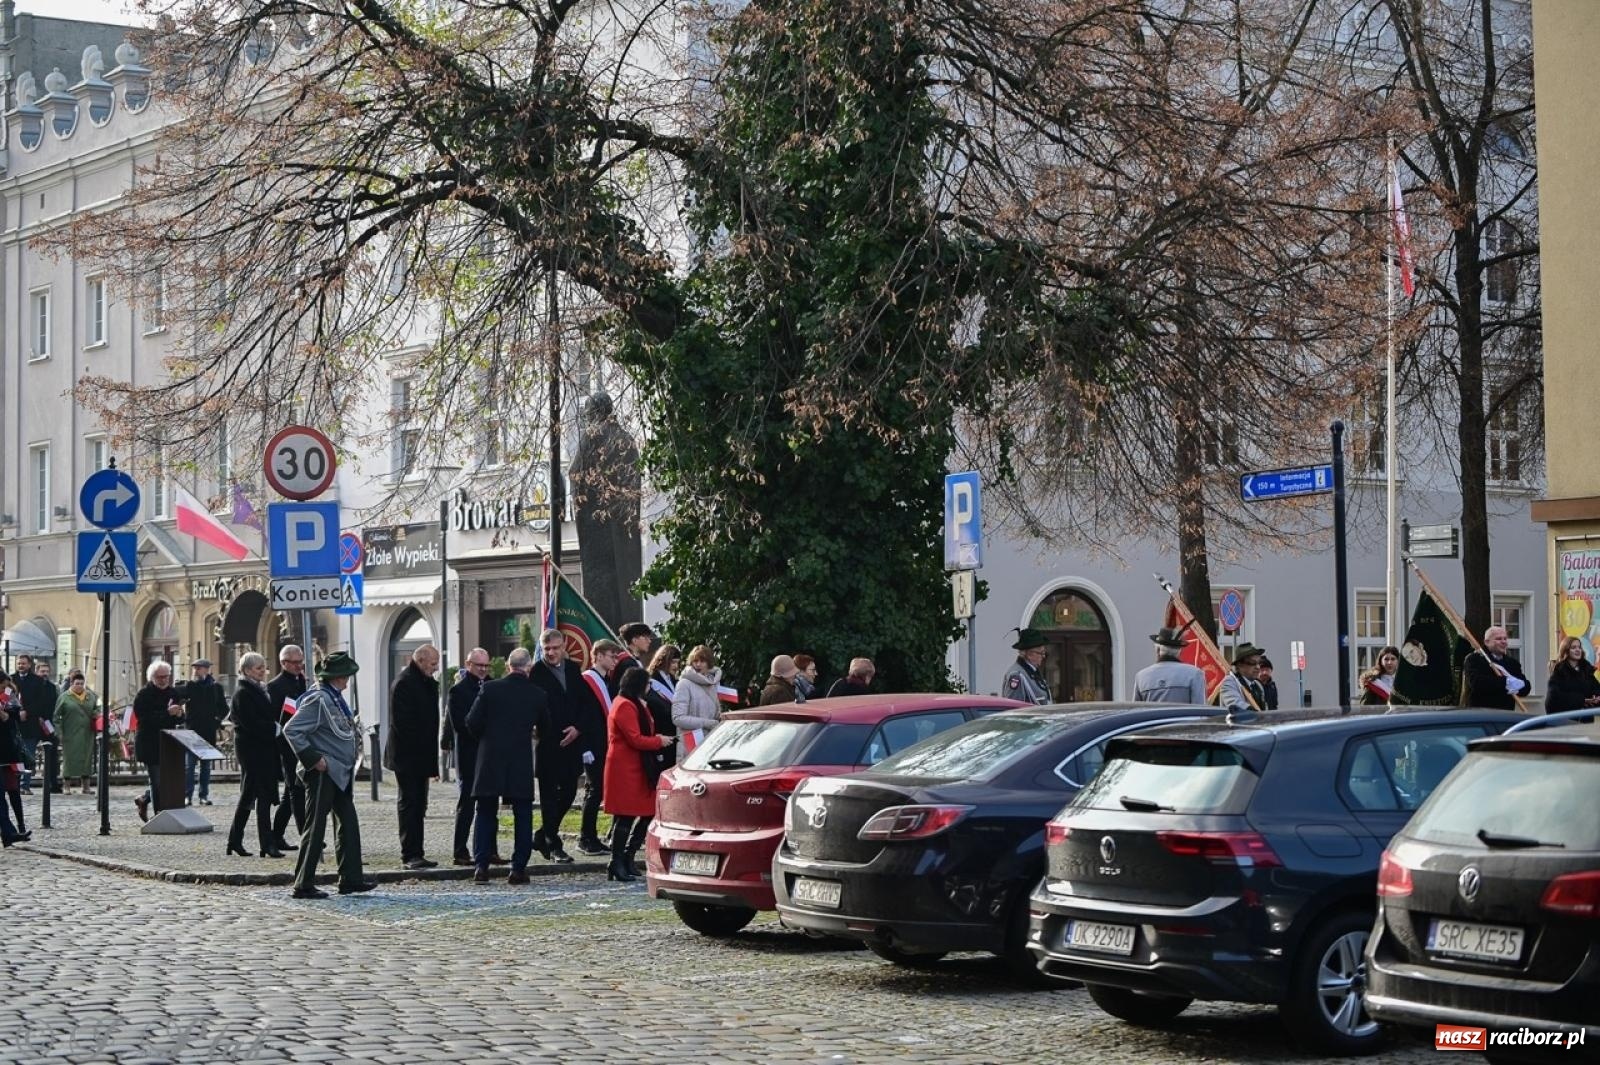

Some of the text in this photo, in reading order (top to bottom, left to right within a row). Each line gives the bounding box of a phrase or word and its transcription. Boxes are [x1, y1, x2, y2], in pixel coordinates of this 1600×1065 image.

[277, 447, 326, 481] 30
[1279, 472, 1311, 481] Informacja
[1257, 481, 1269, 491] 150
[451, 487, 519, 531] Browar
[953, 482, 972, 541] P
[285, 511, 326, 568] P
[365, 541, 439, 569] Złote Wypieki
[272, 584, 341, 603] Koniec
[1567, 576, 1575, 590] z
[1092, 925, 1131, 948] 9290A
[1439, 923, 1519, 956] SRC XE35
